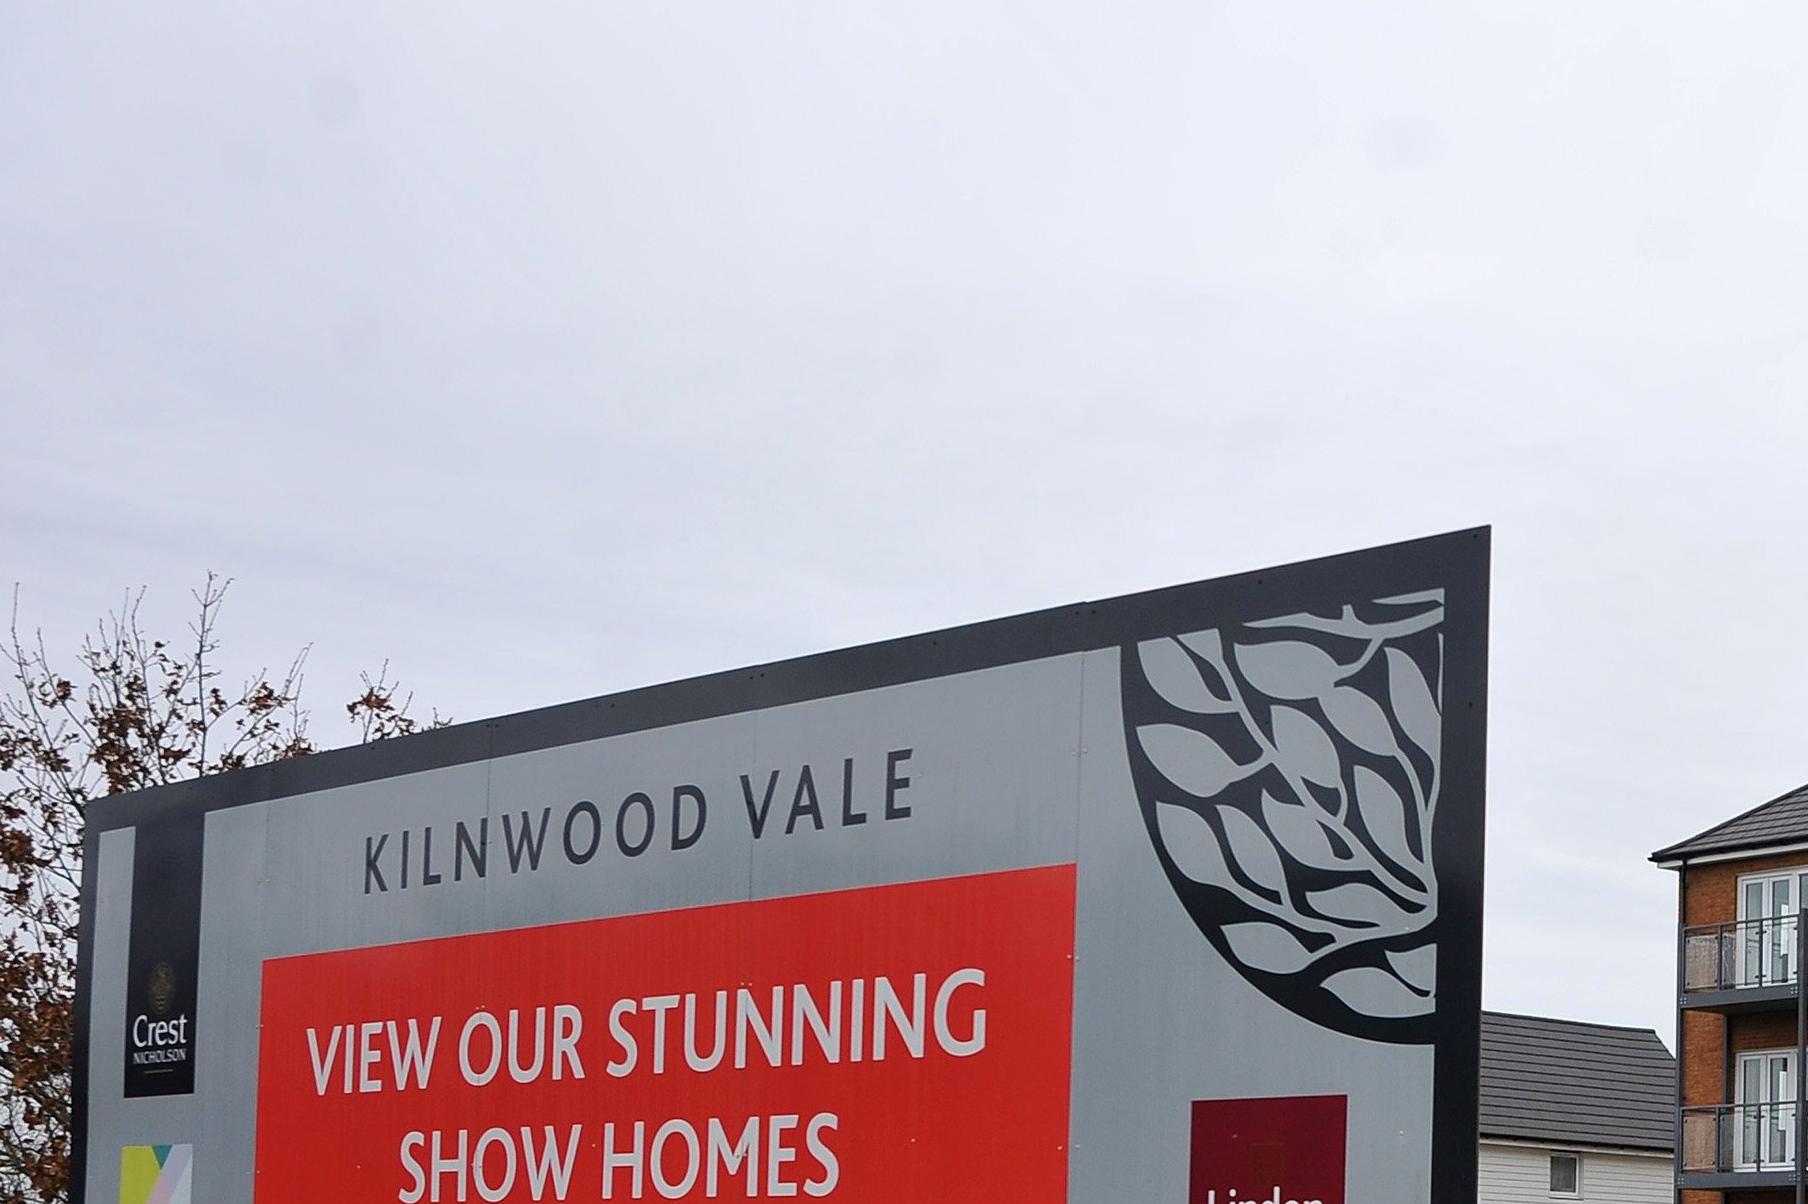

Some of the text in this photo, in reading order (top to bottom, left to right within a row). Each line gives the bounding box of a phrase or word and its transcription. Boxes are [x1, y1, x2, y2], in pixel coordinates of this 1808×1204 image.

[364, 748, 914, 895] KILNWOOD VALE
[132, 1013, 188, 1048] Crest
[132, 1048, 187, 1065] NICHOLSON
[306, 967, 987, 1096] VIEW OUR STUNNING
[398, 1112, 840, 1204] SHOW HOMES
